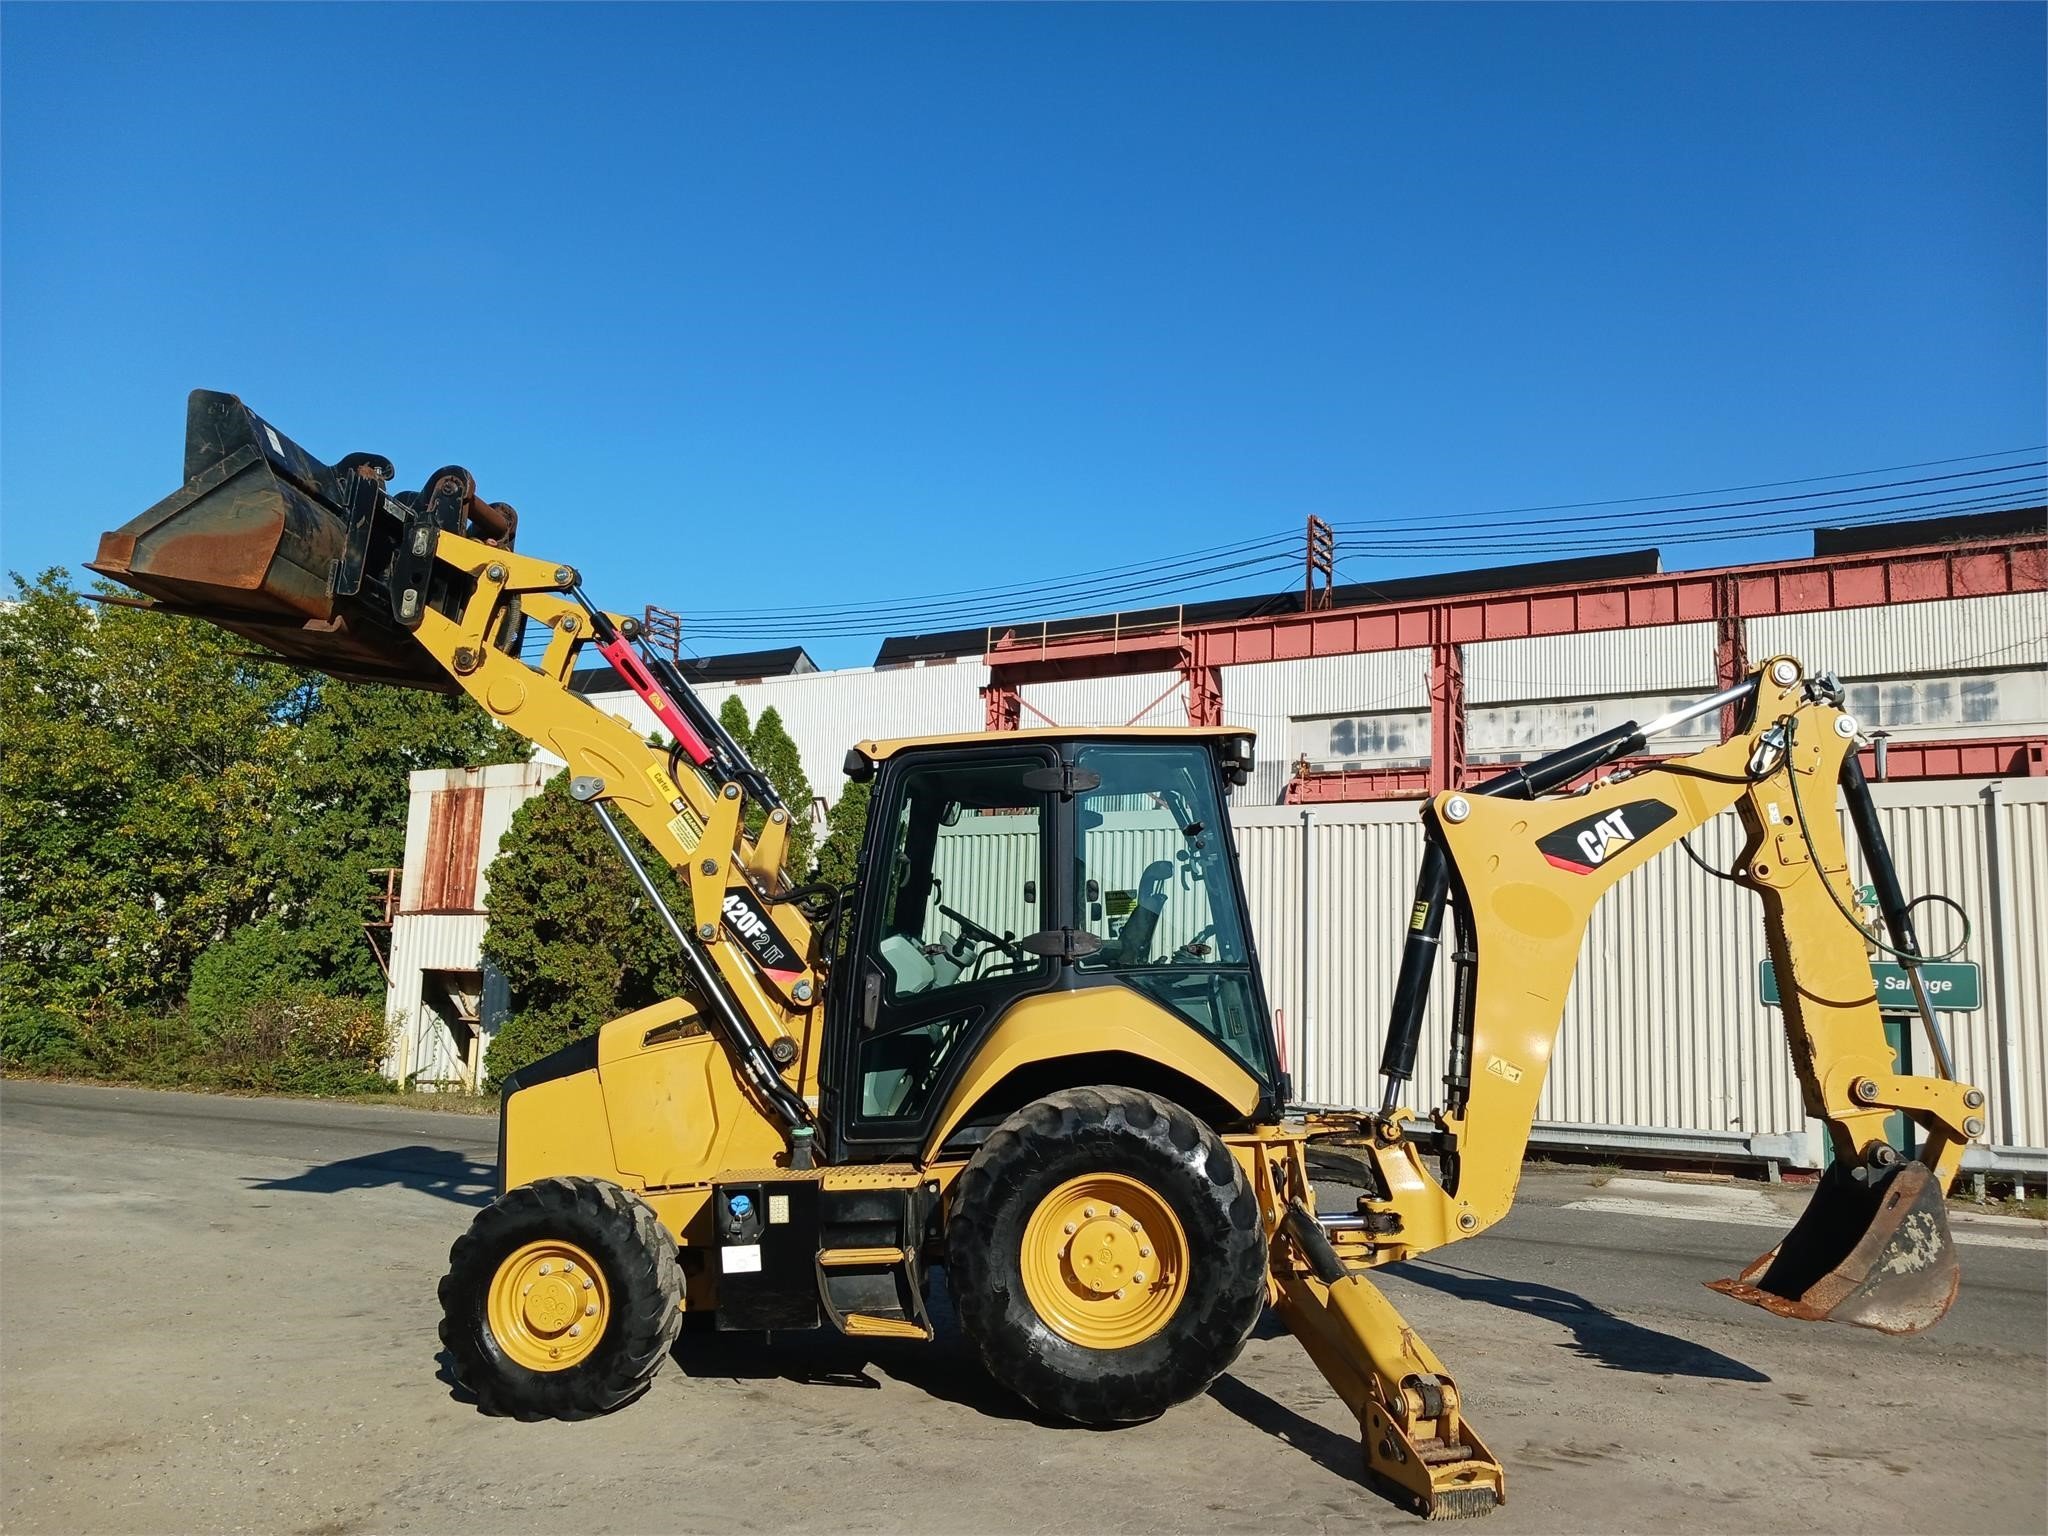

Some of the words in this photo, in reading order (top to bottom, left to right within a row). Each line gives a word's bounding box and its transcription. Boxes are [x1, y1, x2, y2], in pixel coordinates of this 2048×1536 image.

[653, 772, 671, 793] Carter
[1577, 808, 1636, 864] CAT
[762, 945, 785, 964] IT
